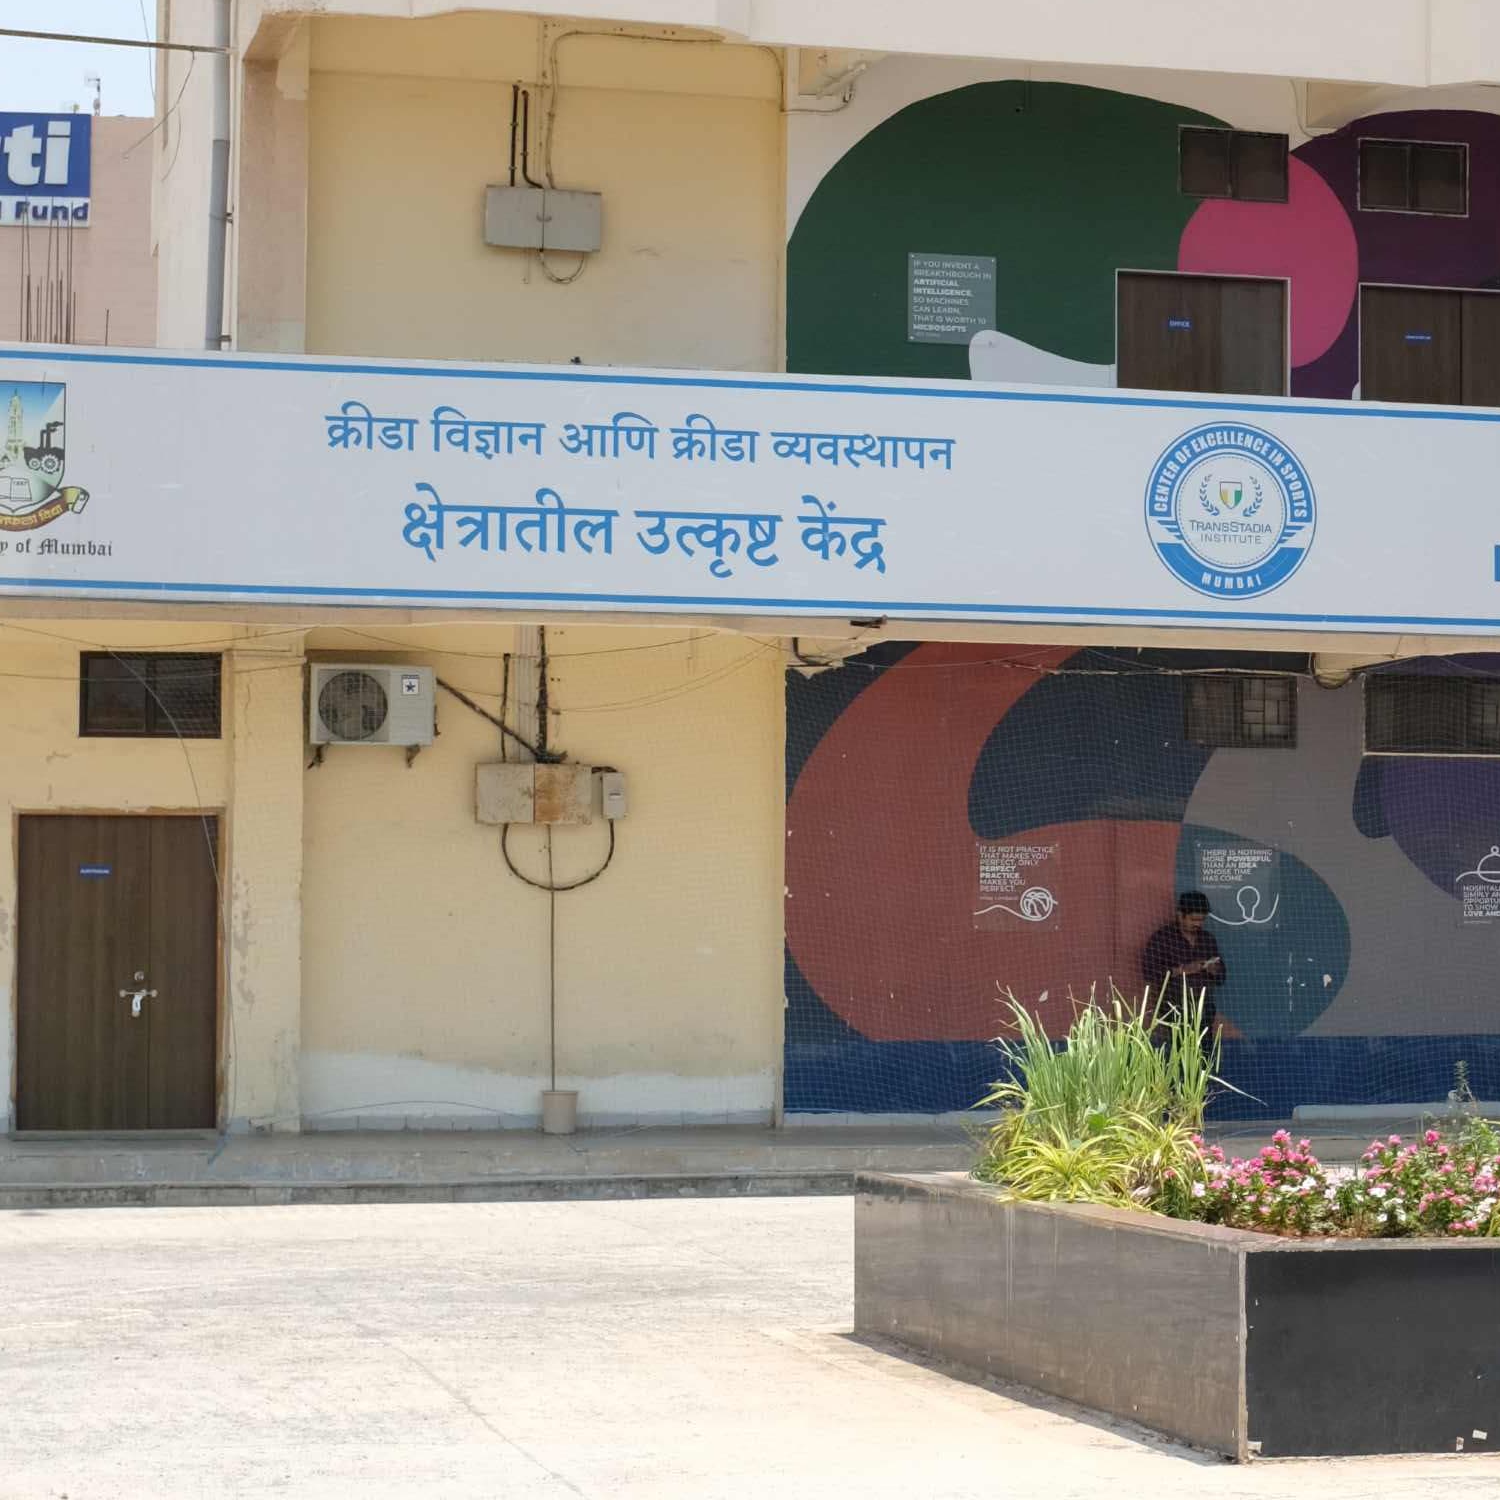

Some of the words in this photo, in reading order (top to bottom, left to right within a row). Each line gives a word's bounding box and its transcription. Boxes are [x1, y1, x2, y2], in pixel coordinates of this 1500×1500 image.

[0, 120, 71, 186] ti
[15, 201, 89, 220] Fund
[324, 400, 420, 451] क्रीडा
[430, 405, 547, 460] विज्ञान
[558, 412, 659, 459] आणि
[670, 413, 760, 463] क्रीडा
[770, 431, 956, 470] व्यवस्थापन
[1153, 462, 1180, 512] CENTER
[1176, 445, 1194, 463] OF
[1190, 431, 1270, 456] EXCELLENCE
[1268, 449, 1286, 467] IN
[1280, 463, 1308, 518] SPORTS
[402, 482, 620, 563] क्षेत्रातील
[633, 510, 784, 579] उत्कृष्ट
[797, 494, 887, 574] केंद्र
[1200, 534, 1262, 545] INSTITUTE
[15, 538, 32, 553] of
[36, 538, 113, 556] Mumbai
[1202, 572, 1262, 589] MUMBAI
[980, 852, 1000, 860] THAT
[1002, 852, 1030, 860] MAKES
[1032, 852, 1048, 860] YOU
